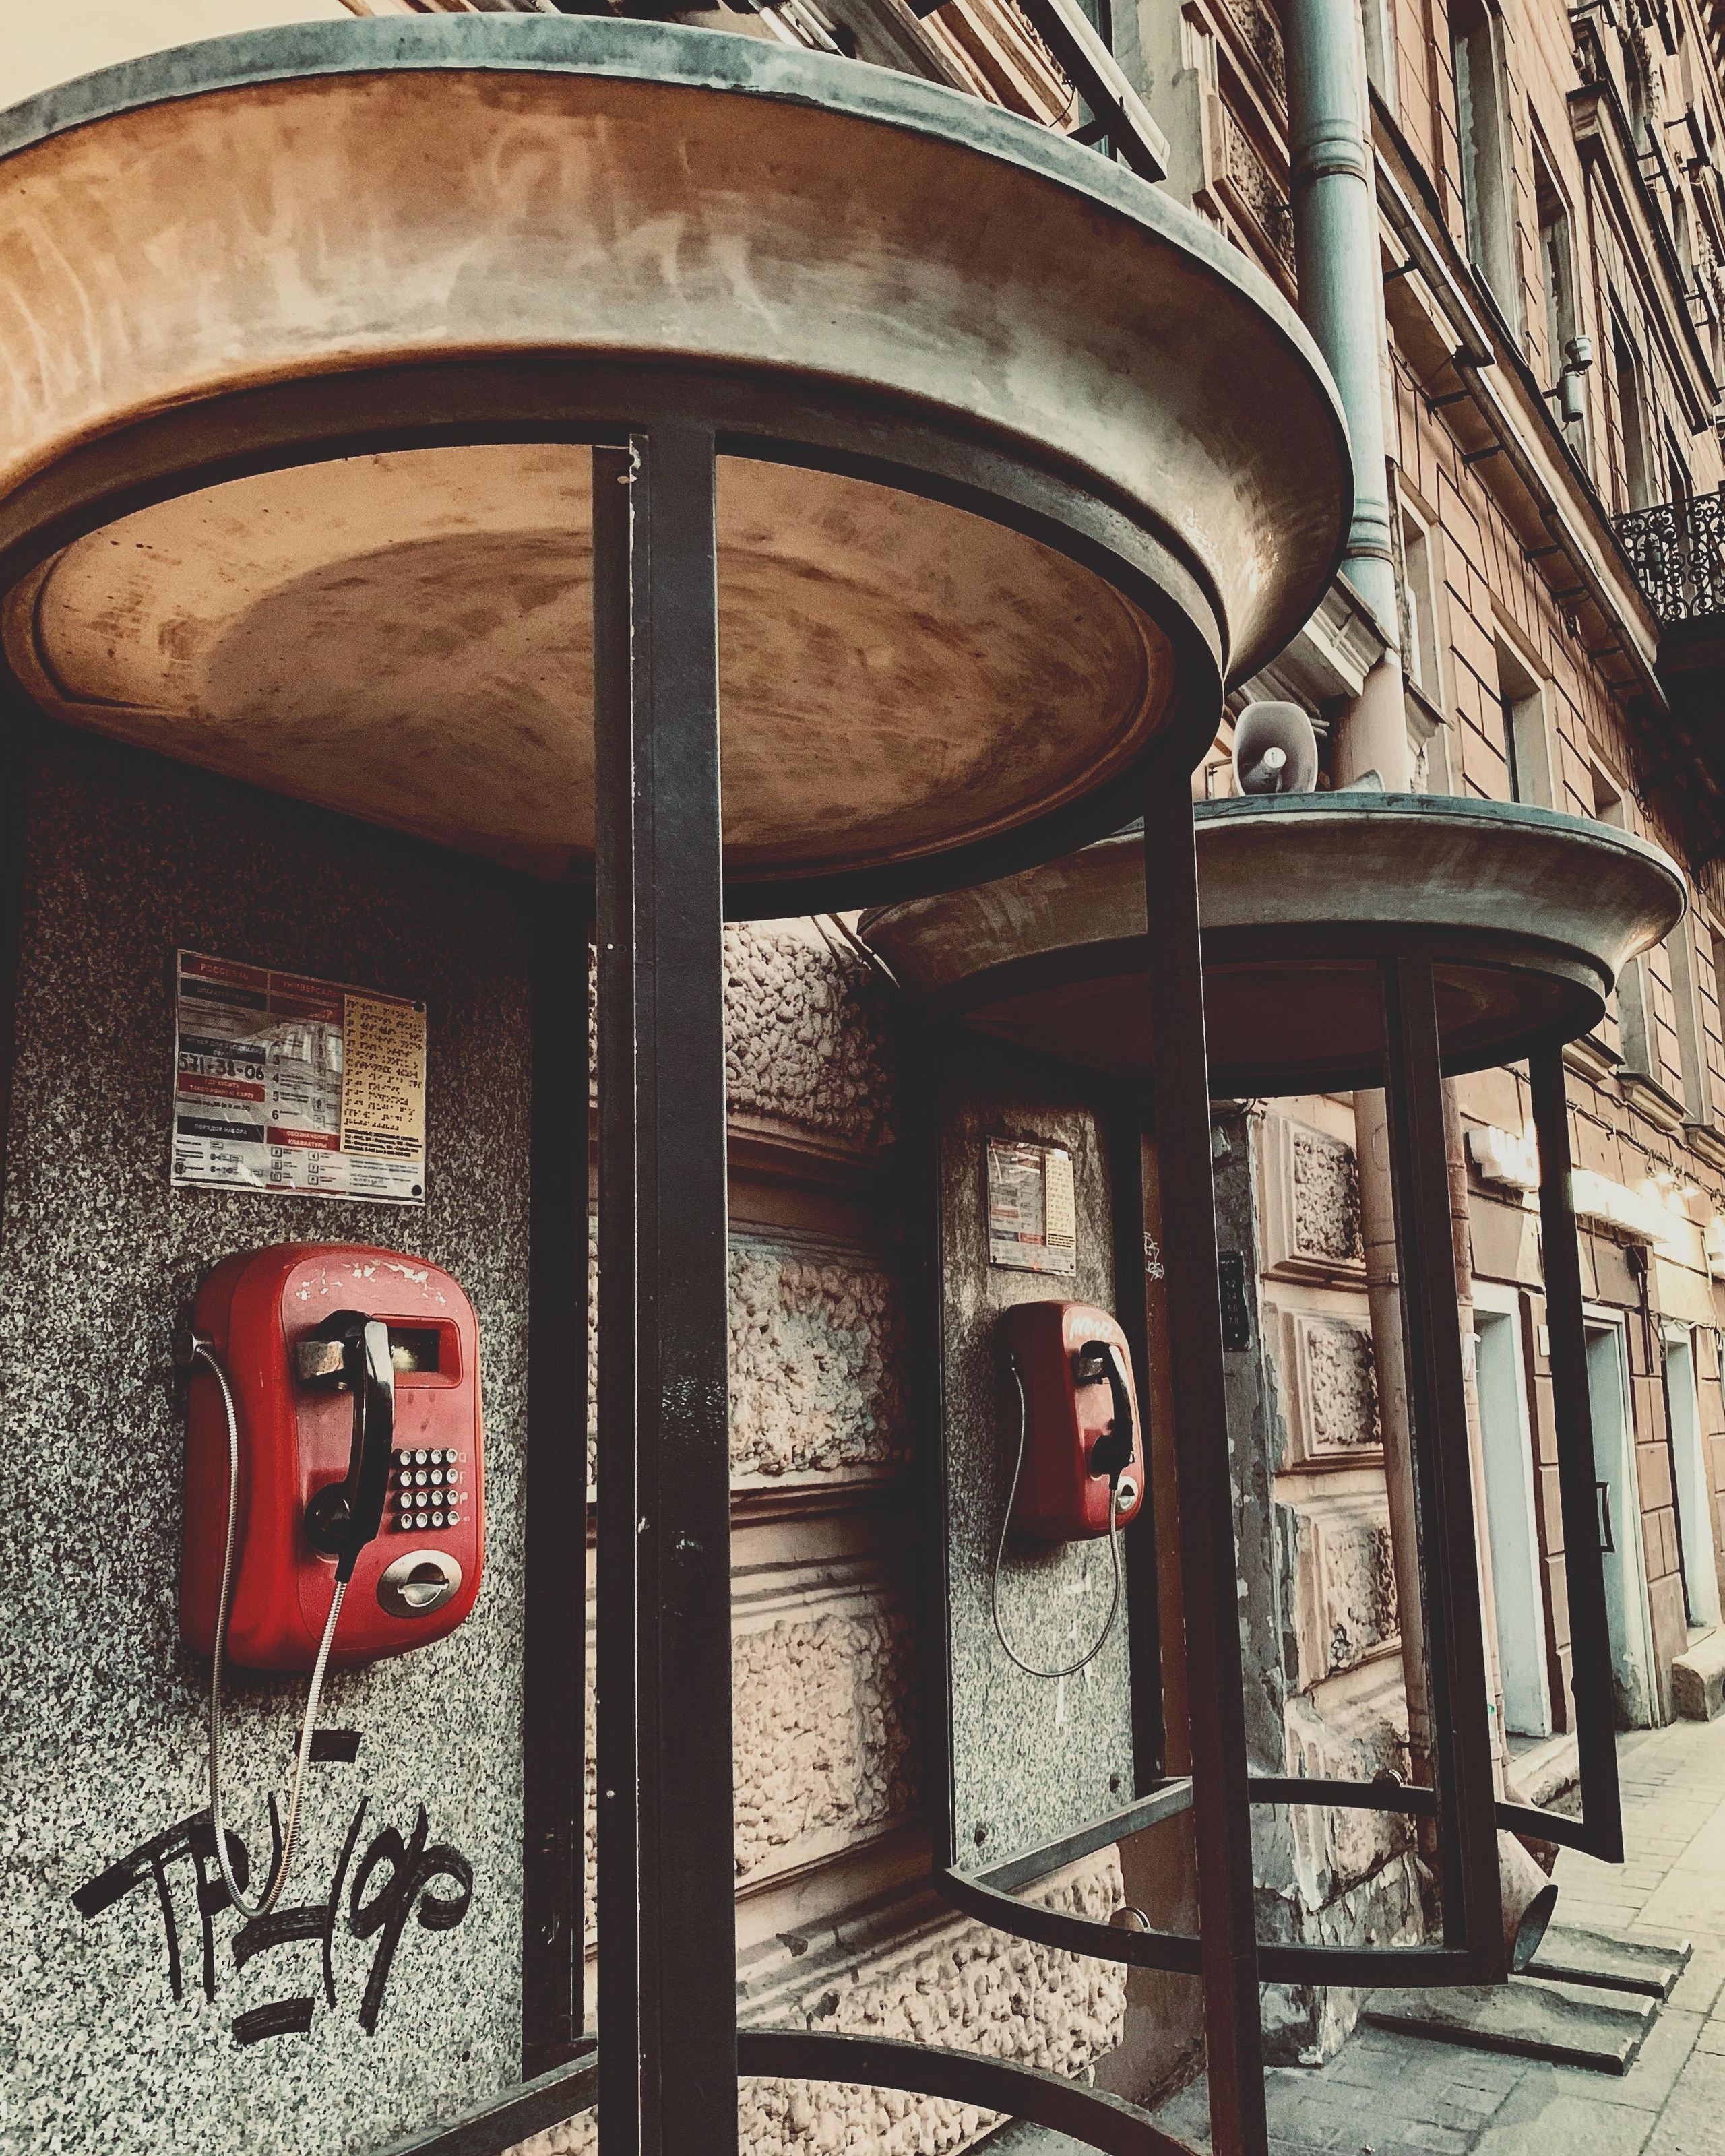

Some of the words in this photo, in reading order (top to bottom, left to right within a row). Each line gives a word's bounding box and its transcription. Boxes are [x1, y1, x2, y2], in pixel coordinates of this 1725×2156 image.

[179, 1052, 265, 1081] 571-38-06
[272, 1073, 280, 1083] 4
[272, 1109, 280, 1120] 6
